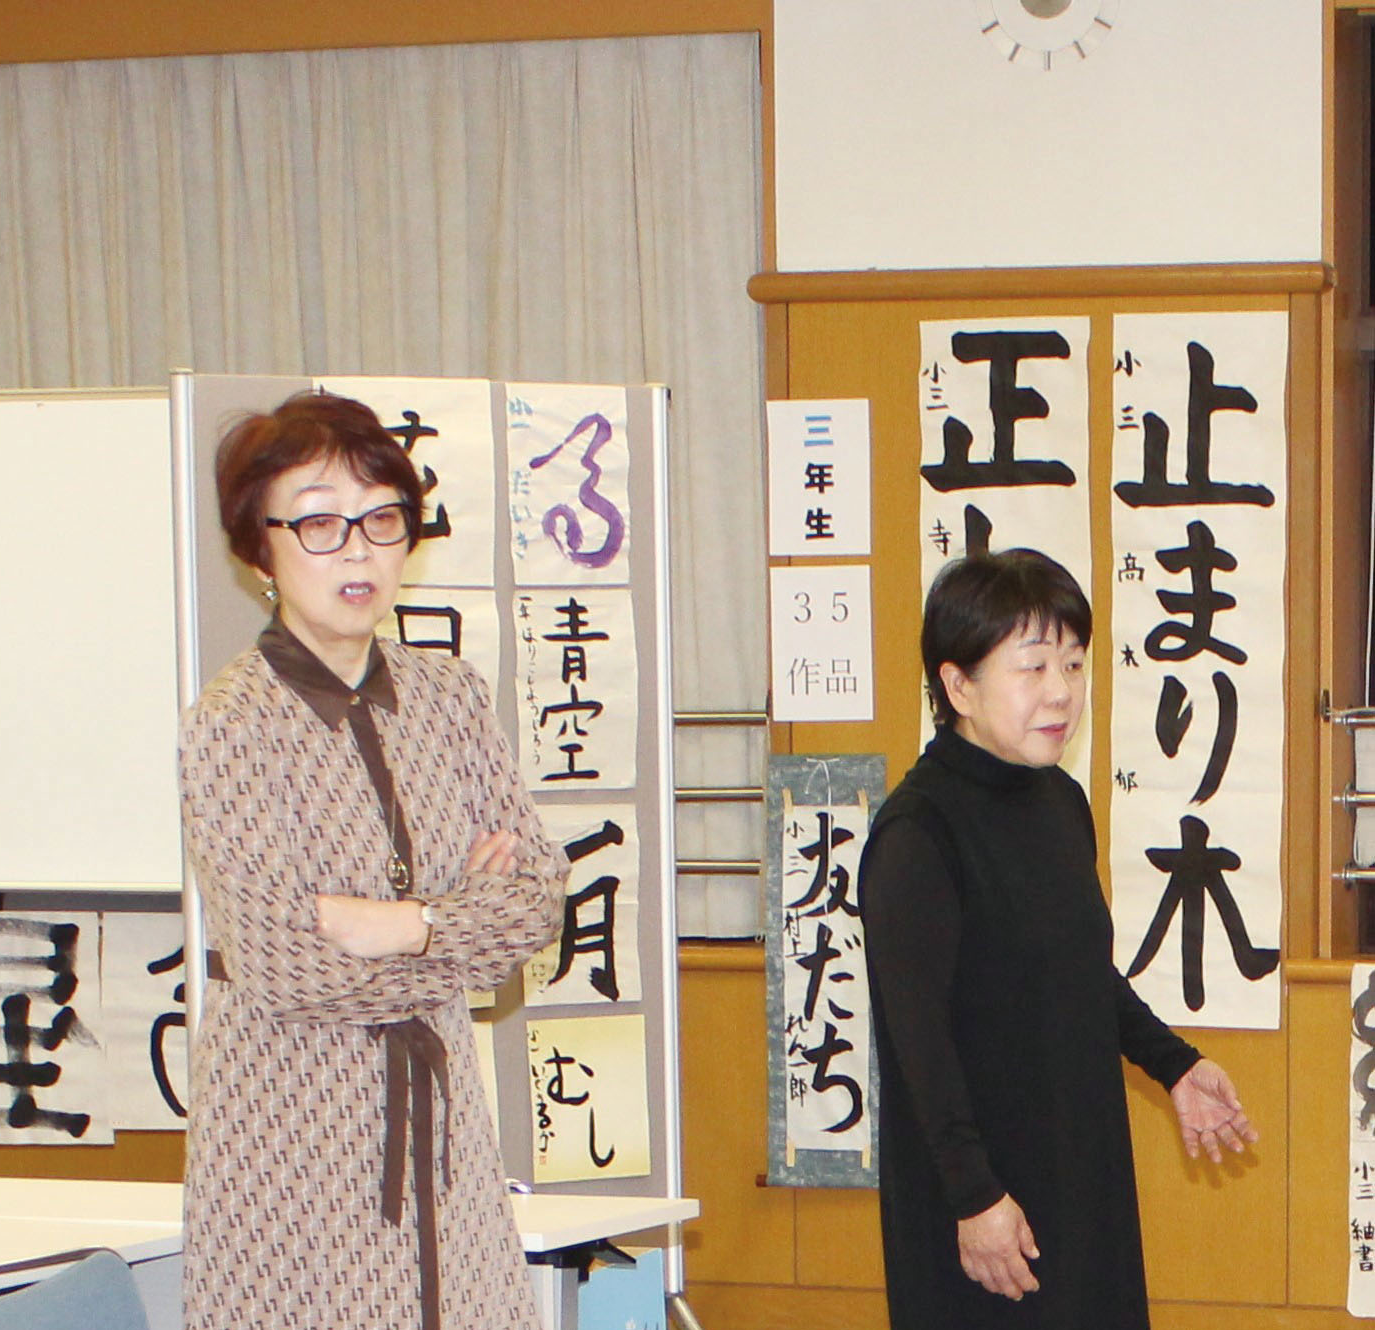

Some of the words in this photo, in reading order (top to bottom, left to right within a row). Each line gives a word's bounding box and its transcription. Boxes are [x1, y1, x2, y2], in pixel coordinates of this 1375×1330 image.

[922, 361, 949, 411] 小三
[1115, 350, 1142, 430] 小三
[803, 414, 836, 541] 三年生
[920, 330, 1078, 558] 正
[793, 591, 850, 624] 35
[540, 597, 610, 781] 青空
[786, 658, 858, 697] 作品
[1112, 340, 1281, 1013] 止まり木
[784, 820, 808, 876] 小三
[784, 907, 807, 957] 村上
[786, 811, 864, 1134] 友だち
[544, 1046, 616, 1168] むし
[1354, 1161, 1375, 1200] 小三
